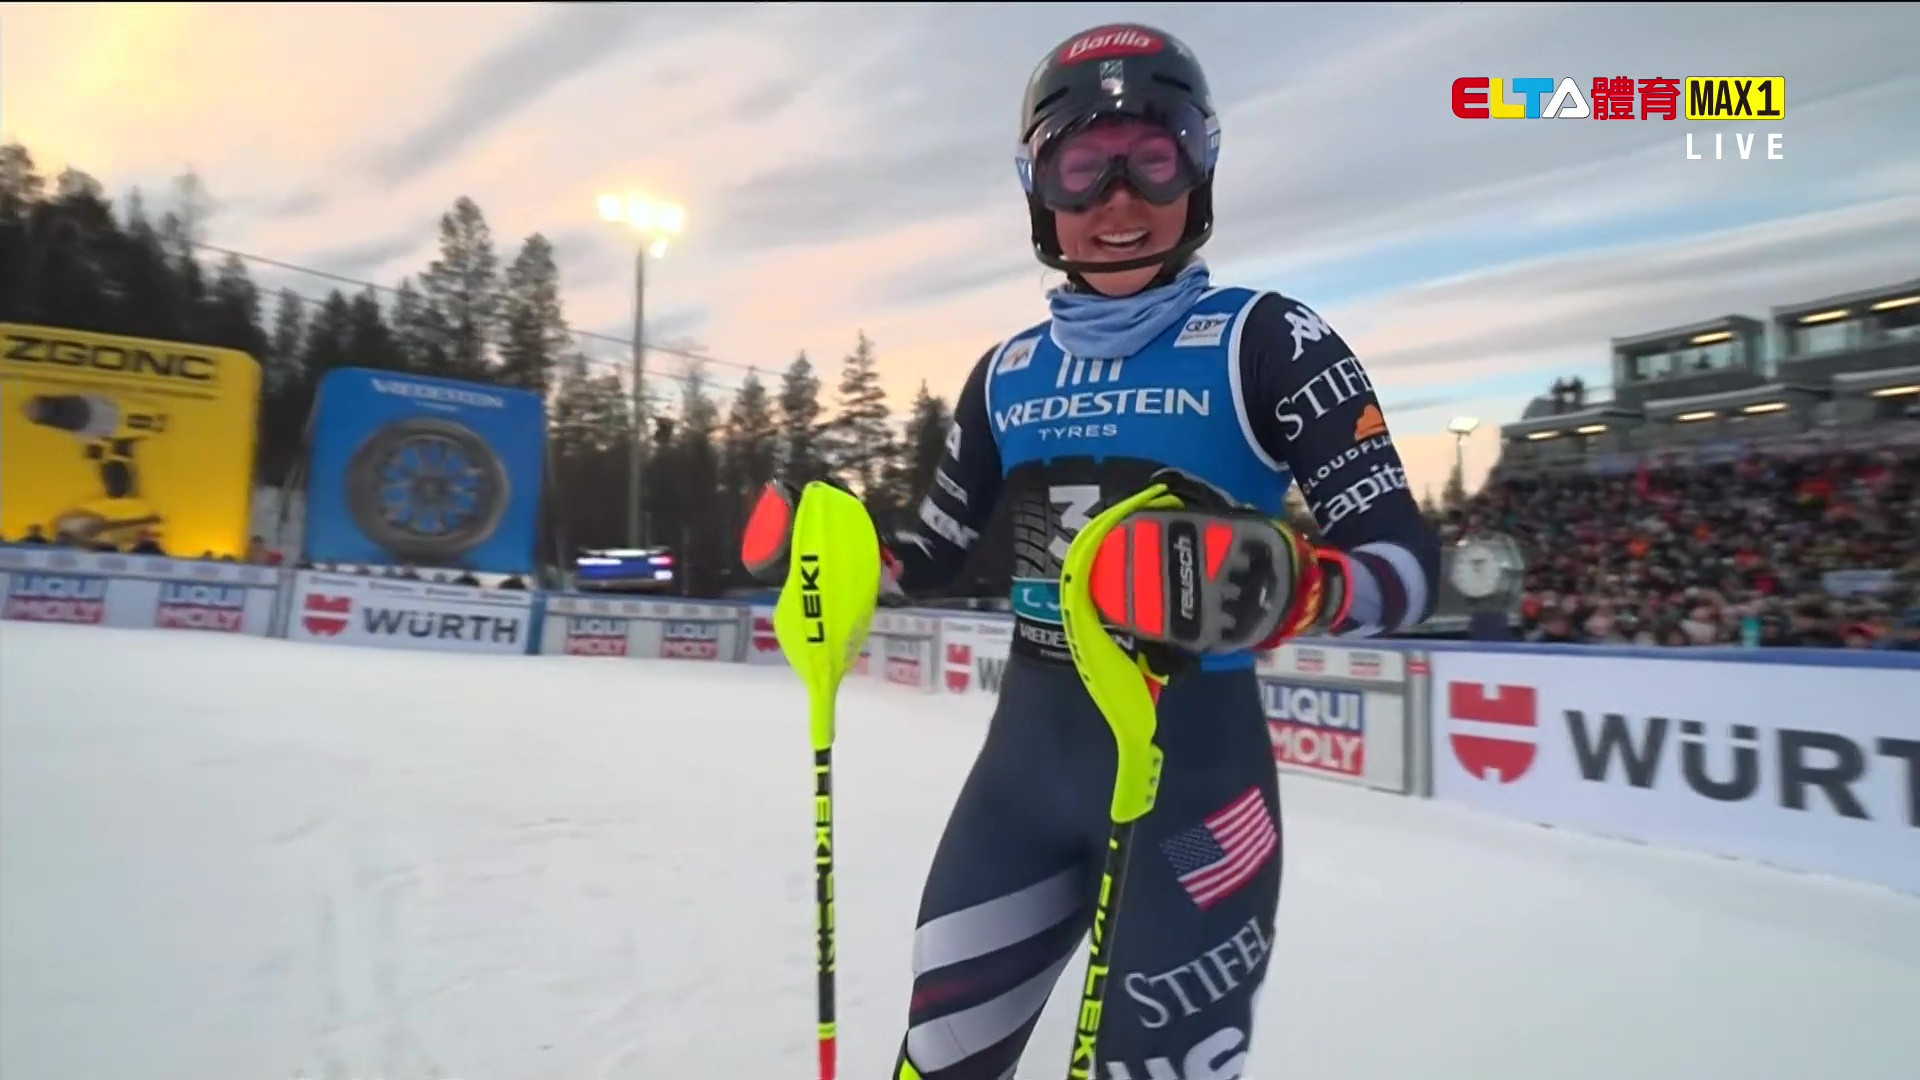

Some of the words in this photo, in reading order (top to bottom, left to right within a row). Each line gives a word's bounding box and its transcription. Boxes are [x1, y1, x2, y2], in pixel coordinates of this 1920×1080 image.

[1068, 29, 1150, 60] Barilla
[5, 334, 214, 380] ZGONC
[995, 387, 1210, 433] VREDESTEIN
[1038, 423, 1118, 441] TYRES
[800, 555, 825, 643] LEKI
[1173, 535, 1194, 620] reusch
[363, 607, 520, 644] WÜRTH
[1265, 682, 1361, 730] LIQUI
[1269, 722, 1362, 771] MOLY
